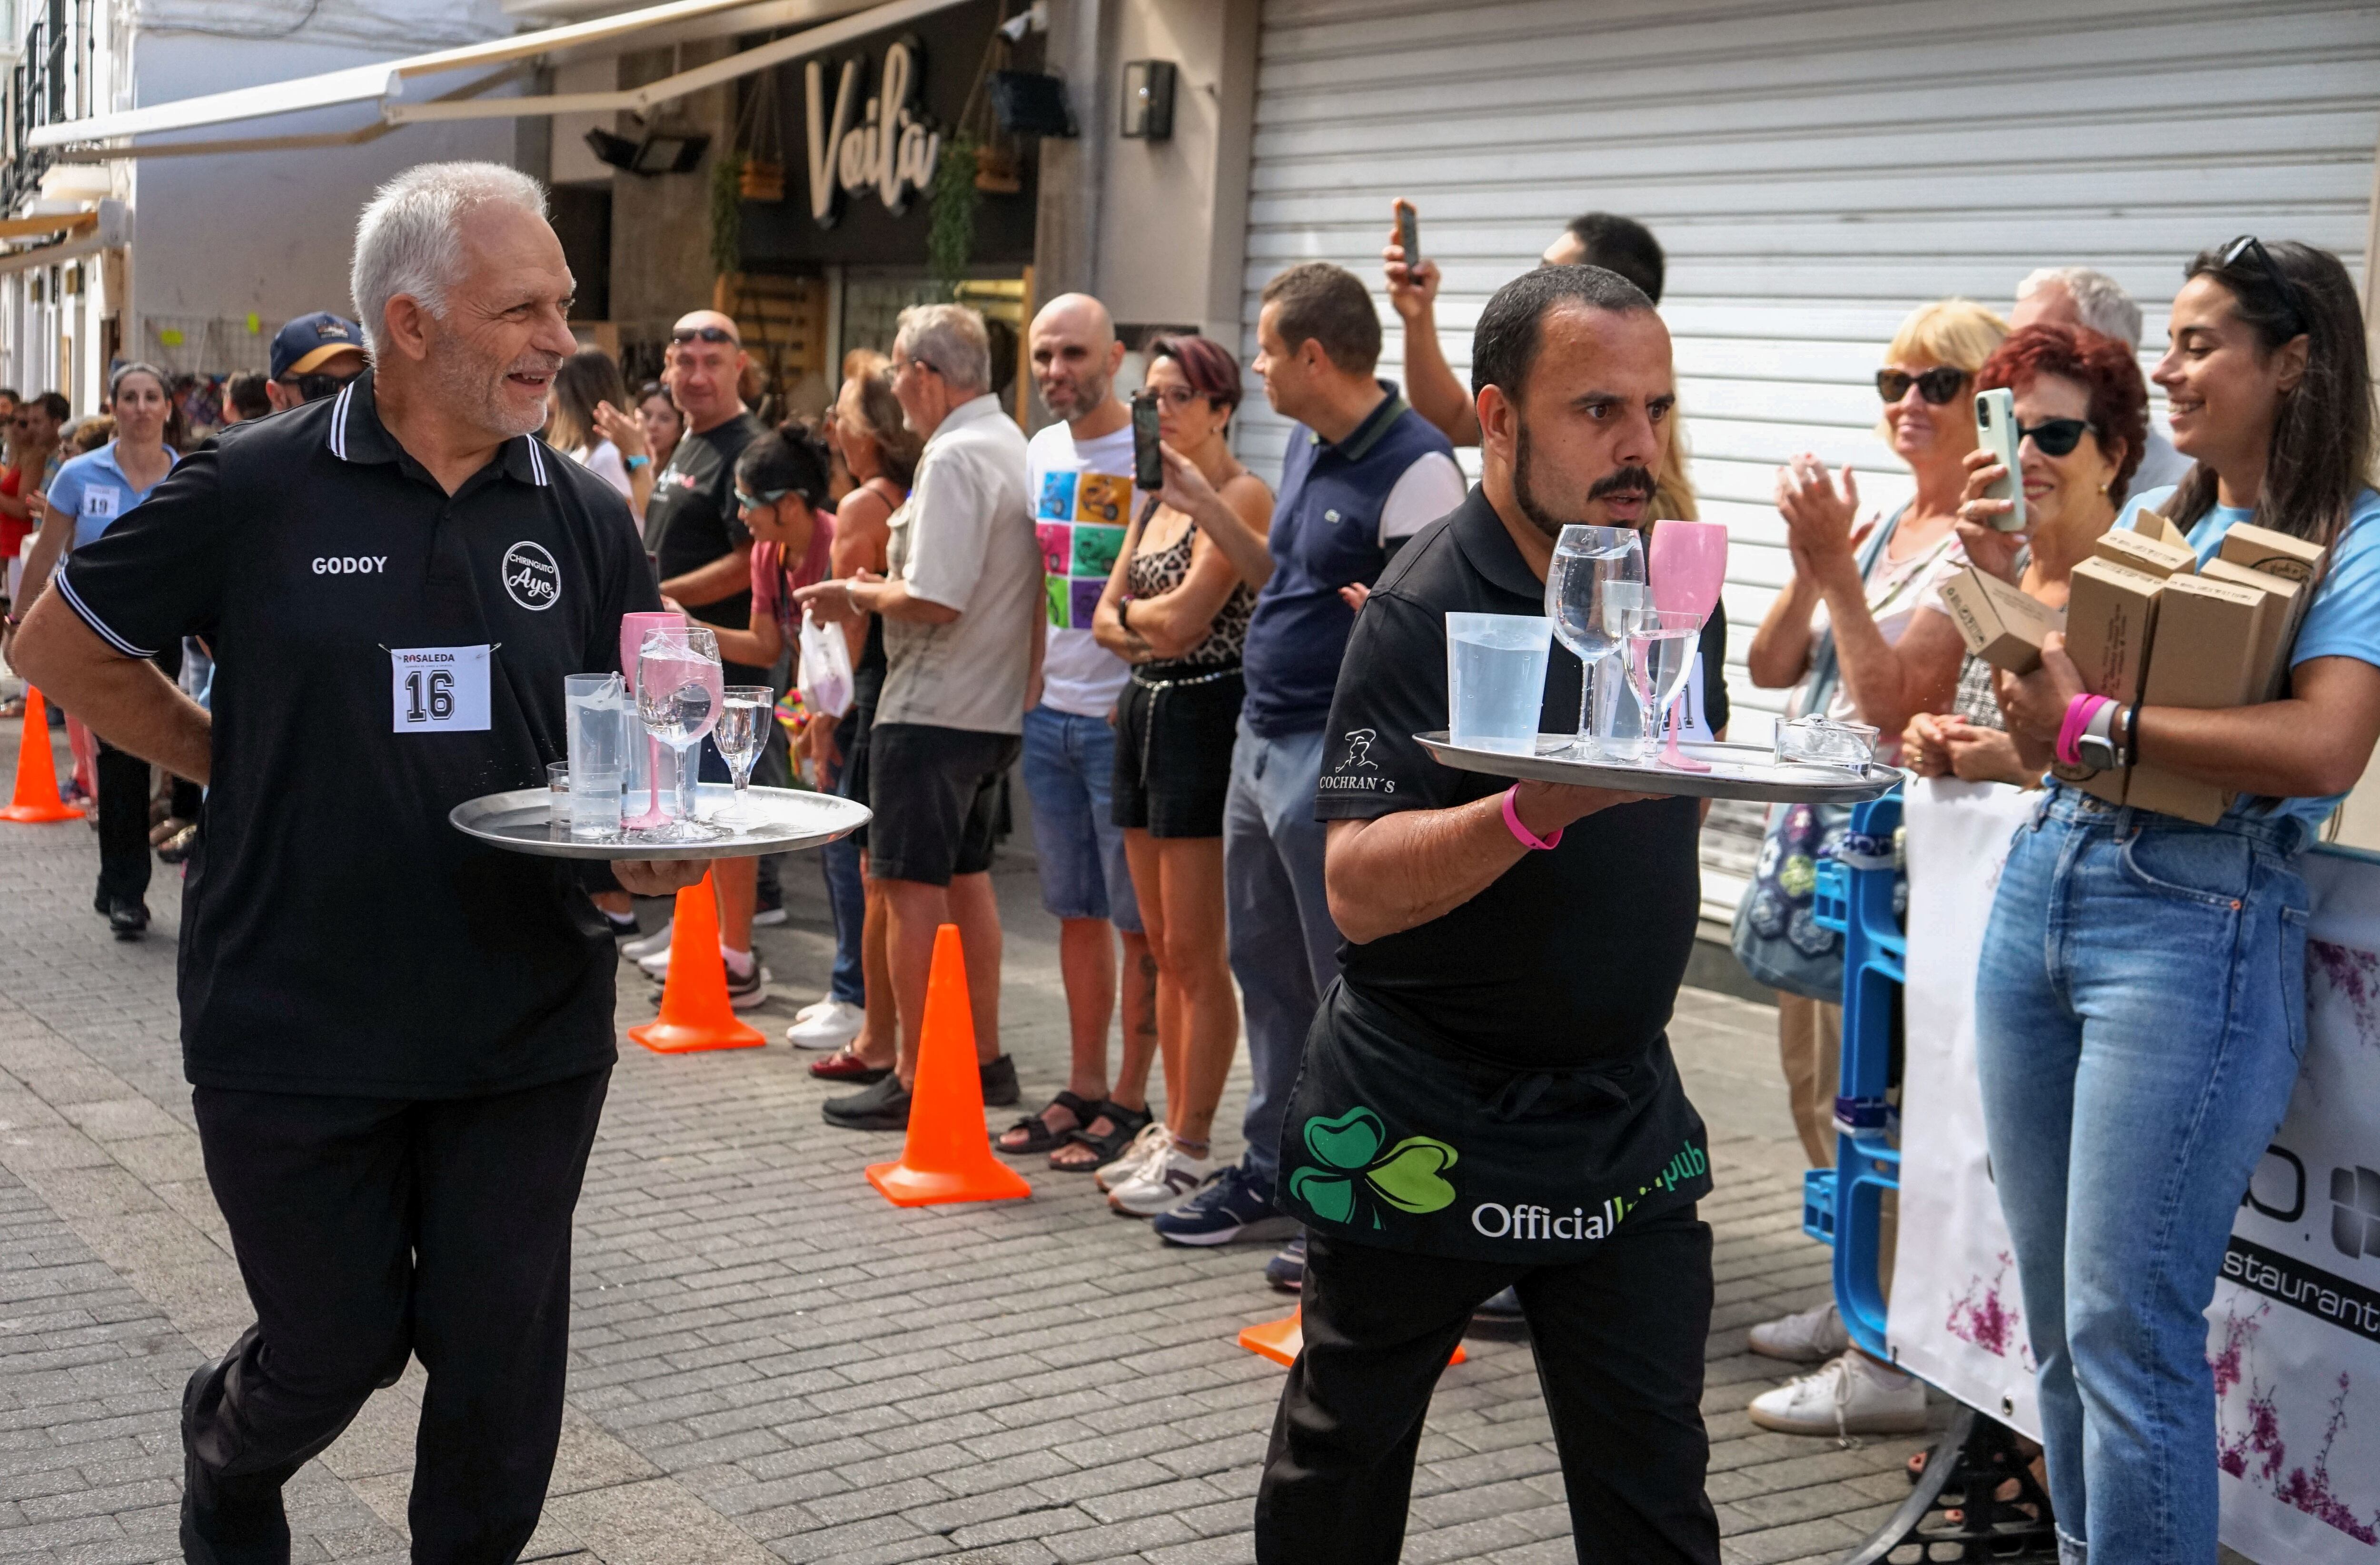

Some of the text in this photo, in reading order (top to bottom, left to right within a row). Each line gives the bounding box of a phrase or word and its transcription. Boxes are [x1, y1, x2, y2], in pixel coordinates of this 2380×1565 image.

[312, 556, 388, 574] GODOY
[509, 554, 554, 574] CHIRINGUITO
[508, 567, 555, 599] Ayo
[405, 669, 455, 723] 16
[2222, 1249, 2380, 1333] staurant
